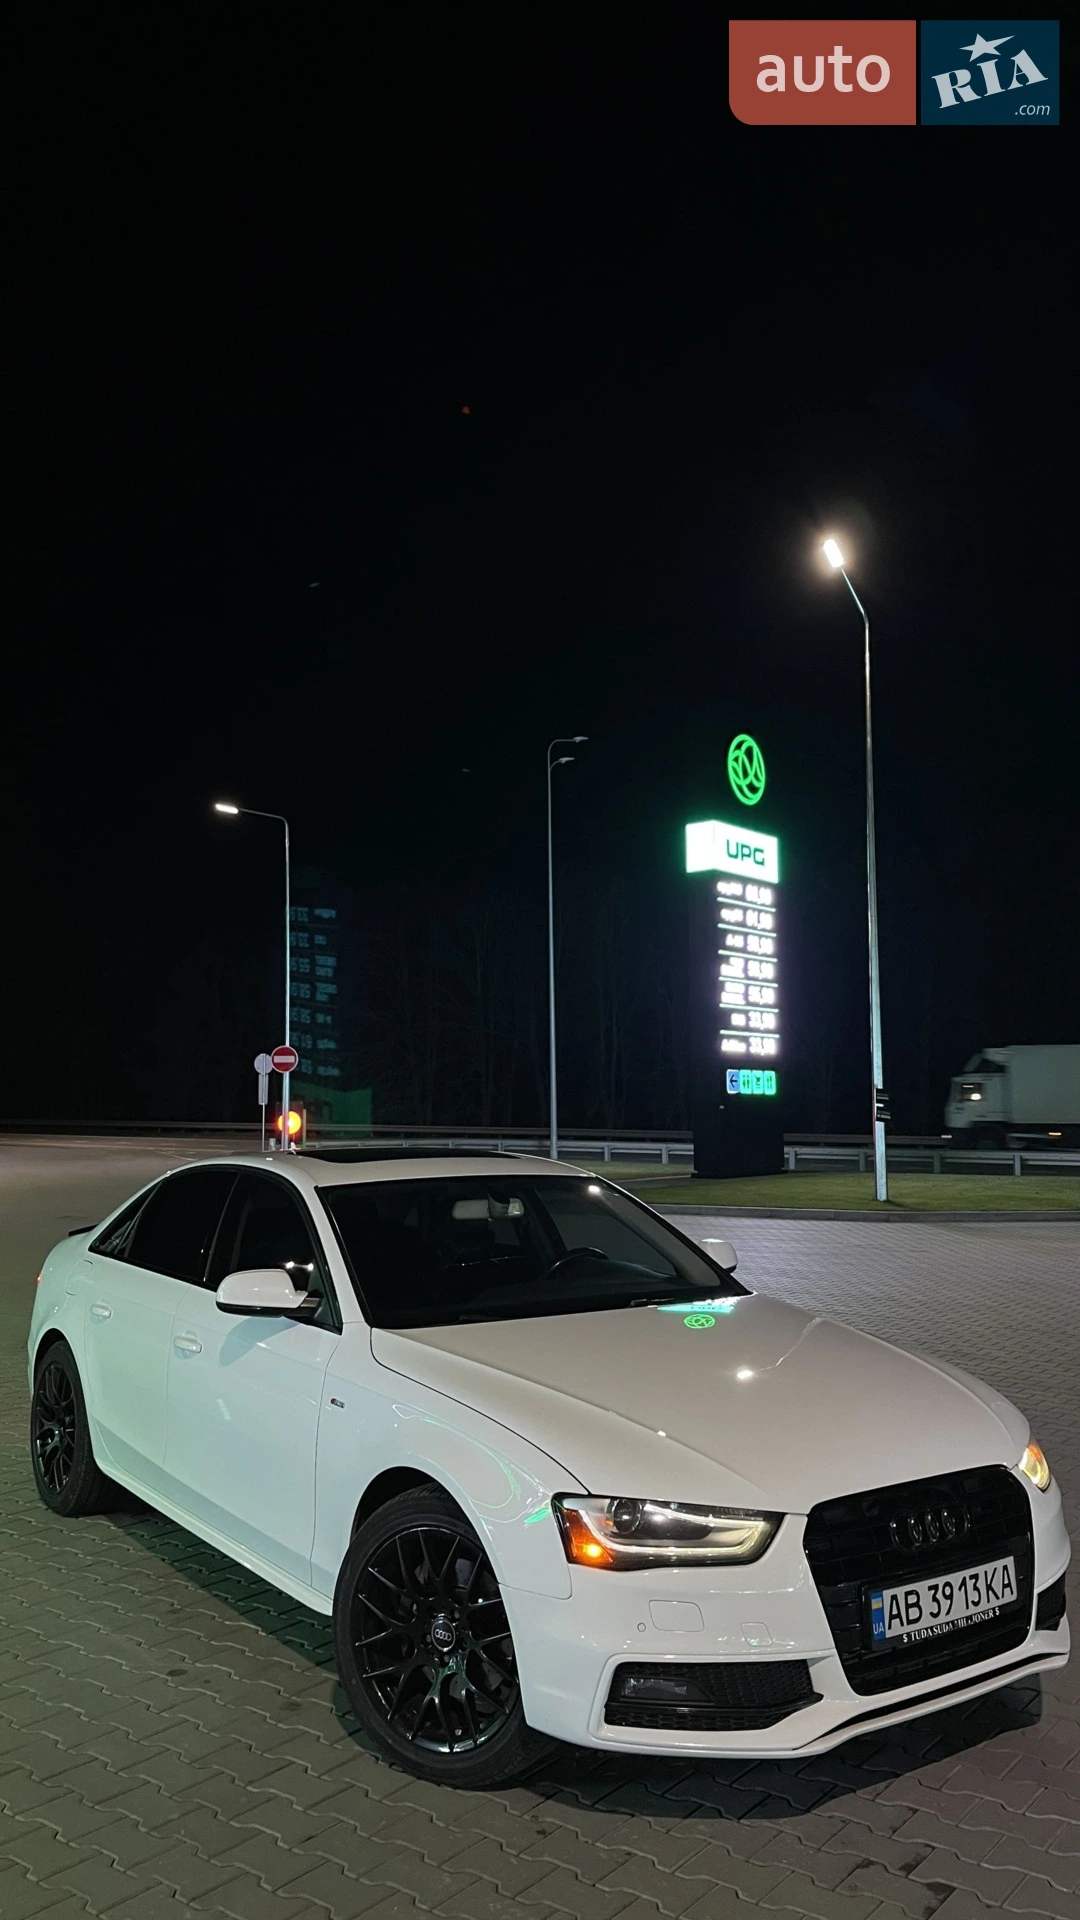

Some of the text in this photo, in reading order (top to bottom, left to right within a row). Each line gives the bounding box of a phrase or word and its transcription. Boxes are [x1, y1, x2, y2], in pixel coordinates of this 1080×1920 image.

[726, 839, 765, 866] UPG
[887, 1589, 923, 1631] AB
[984, 1564, 1014, 1604] KA
[873, 1621, 885, 1635] UA
[910, 1628, 933, 1642] TUDA
[932, 1623, 953, 1636] SUDA
